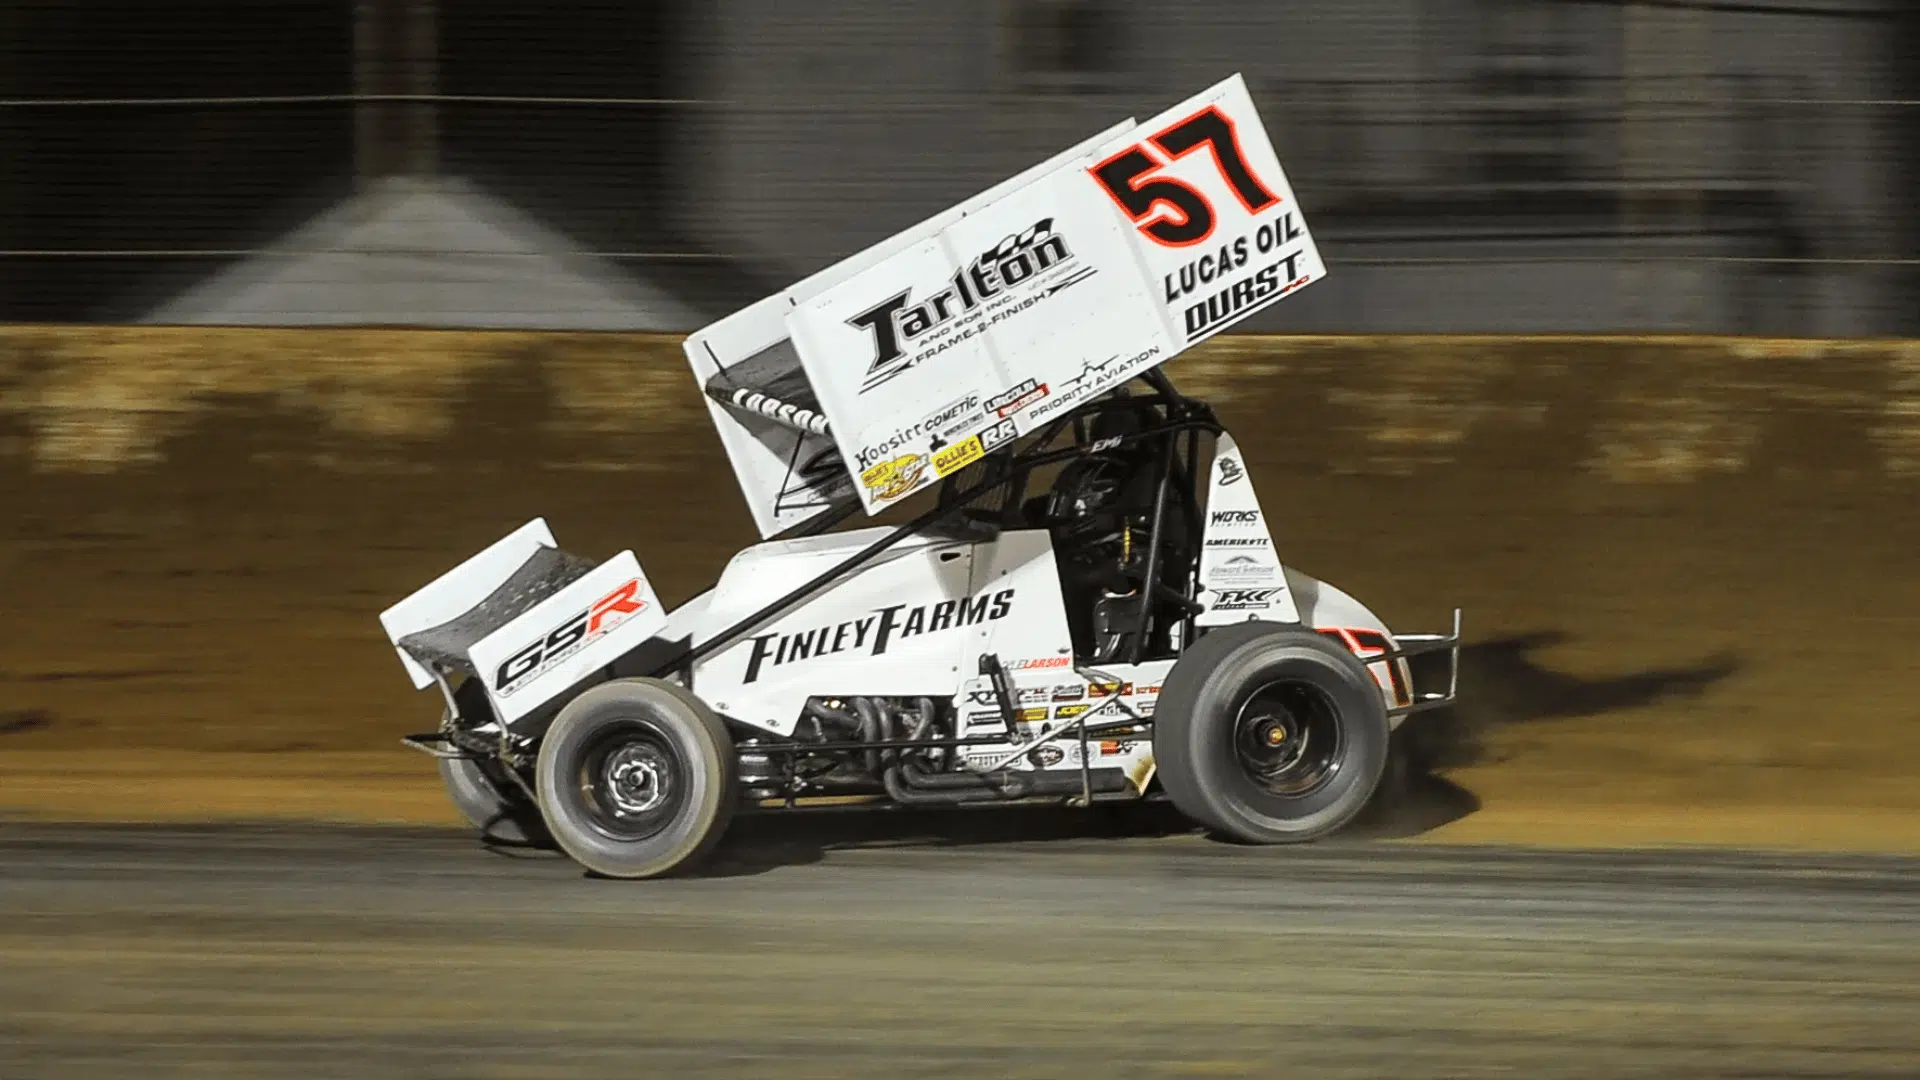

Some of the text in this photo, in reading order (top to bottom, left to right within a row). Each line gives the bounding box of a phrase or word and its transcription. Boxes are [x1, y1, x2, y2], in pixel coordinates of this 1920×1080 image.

[1087, 104, 1282, 248] 57
[1164, 211, 1301, 304] LUCAS OIL
[1184, 249, 1304, 335] DURST
[844, 232, 1075, 375] Tarlton
[917, 326, 950, 348] AND
[954, 310, 983, 328] SON
[1029, 345, 1161, 421] PRIORITY AVIATION
[935, 439, 979, 468] OLLIE'S
[982, 421, 1016, 449] RR
[1211, 510, 1259, 527] WORKS
[495, 579, 646, 691] GSR
[742, 588, 1015, 684] FINLEY FARMS
